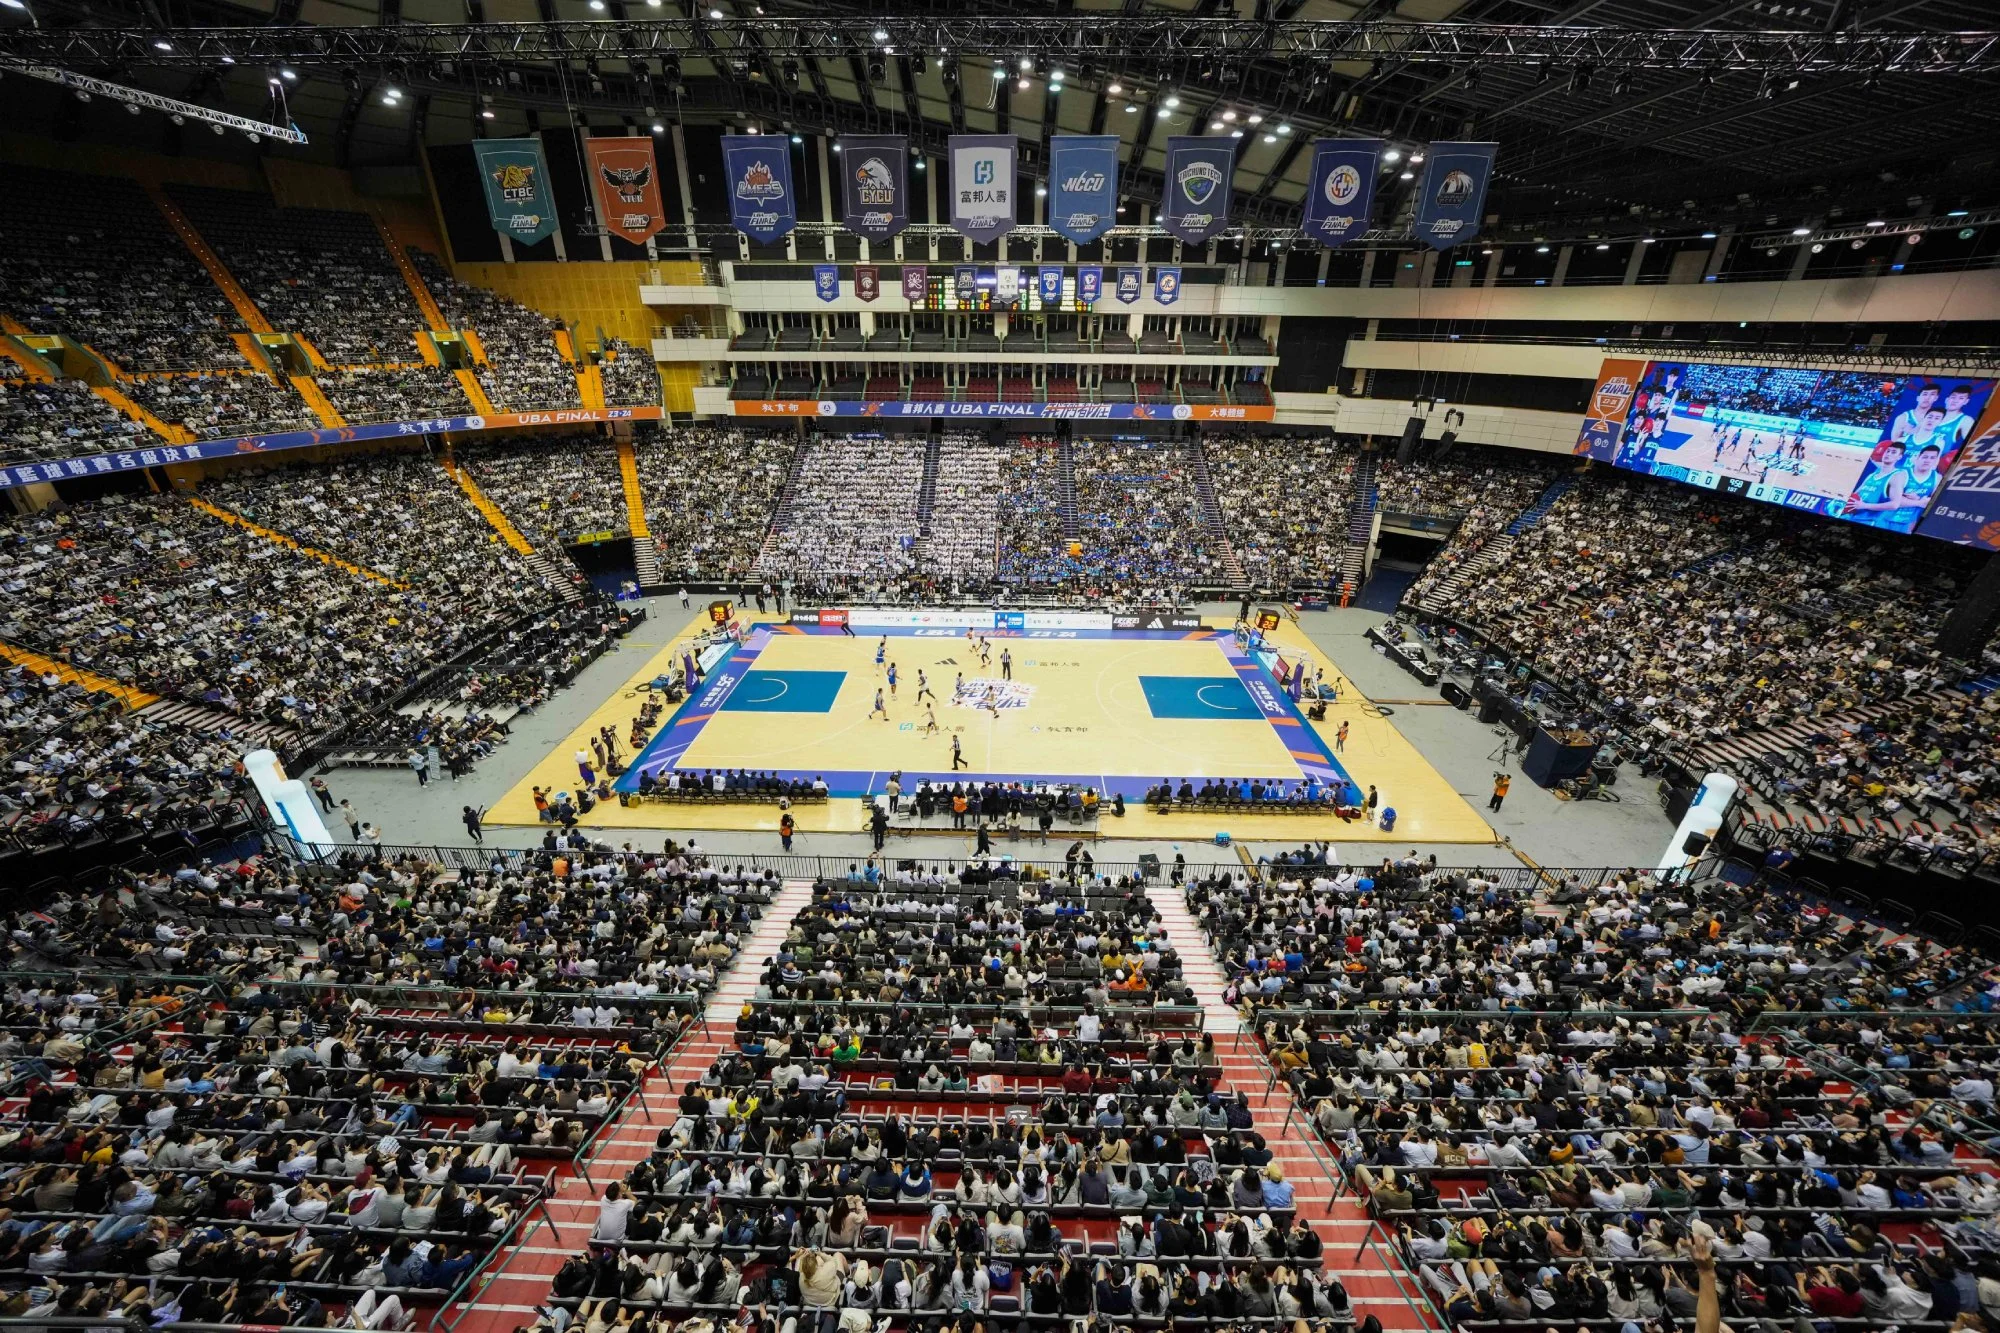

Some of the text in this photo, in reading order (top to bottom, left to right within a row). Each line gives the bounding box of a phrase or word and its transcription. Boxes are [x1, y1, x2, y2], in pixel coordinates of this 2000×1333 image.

[1062, 171, 1105, 191] NCCU
[504, 187, 533, 198] CTBC
[862, 189, 892, 203] CYCU
[960, 190, 1006, 203] 富邦人壽
[1599, 383, 1630, 395] FINAL
[762, 403, 799, 413] 教育部
[902, 404, 945, 414] 富邦人壽
[950, 404, 983, 414] UBA
[987, 404, 1035, 415] FINAL
[518, 414, 551, 424] UBA
[556, 412, 601, 422] FINAL
[398, 420, 451, 434] 教育部
[1705, 476, 1713, 485] 0
[1756, 487, 1764, 497] 0
[1786, 492, 1821, 509] UCH
[714, 612, 725, 620] 22
[1263, 620, 1275, 629] 22
